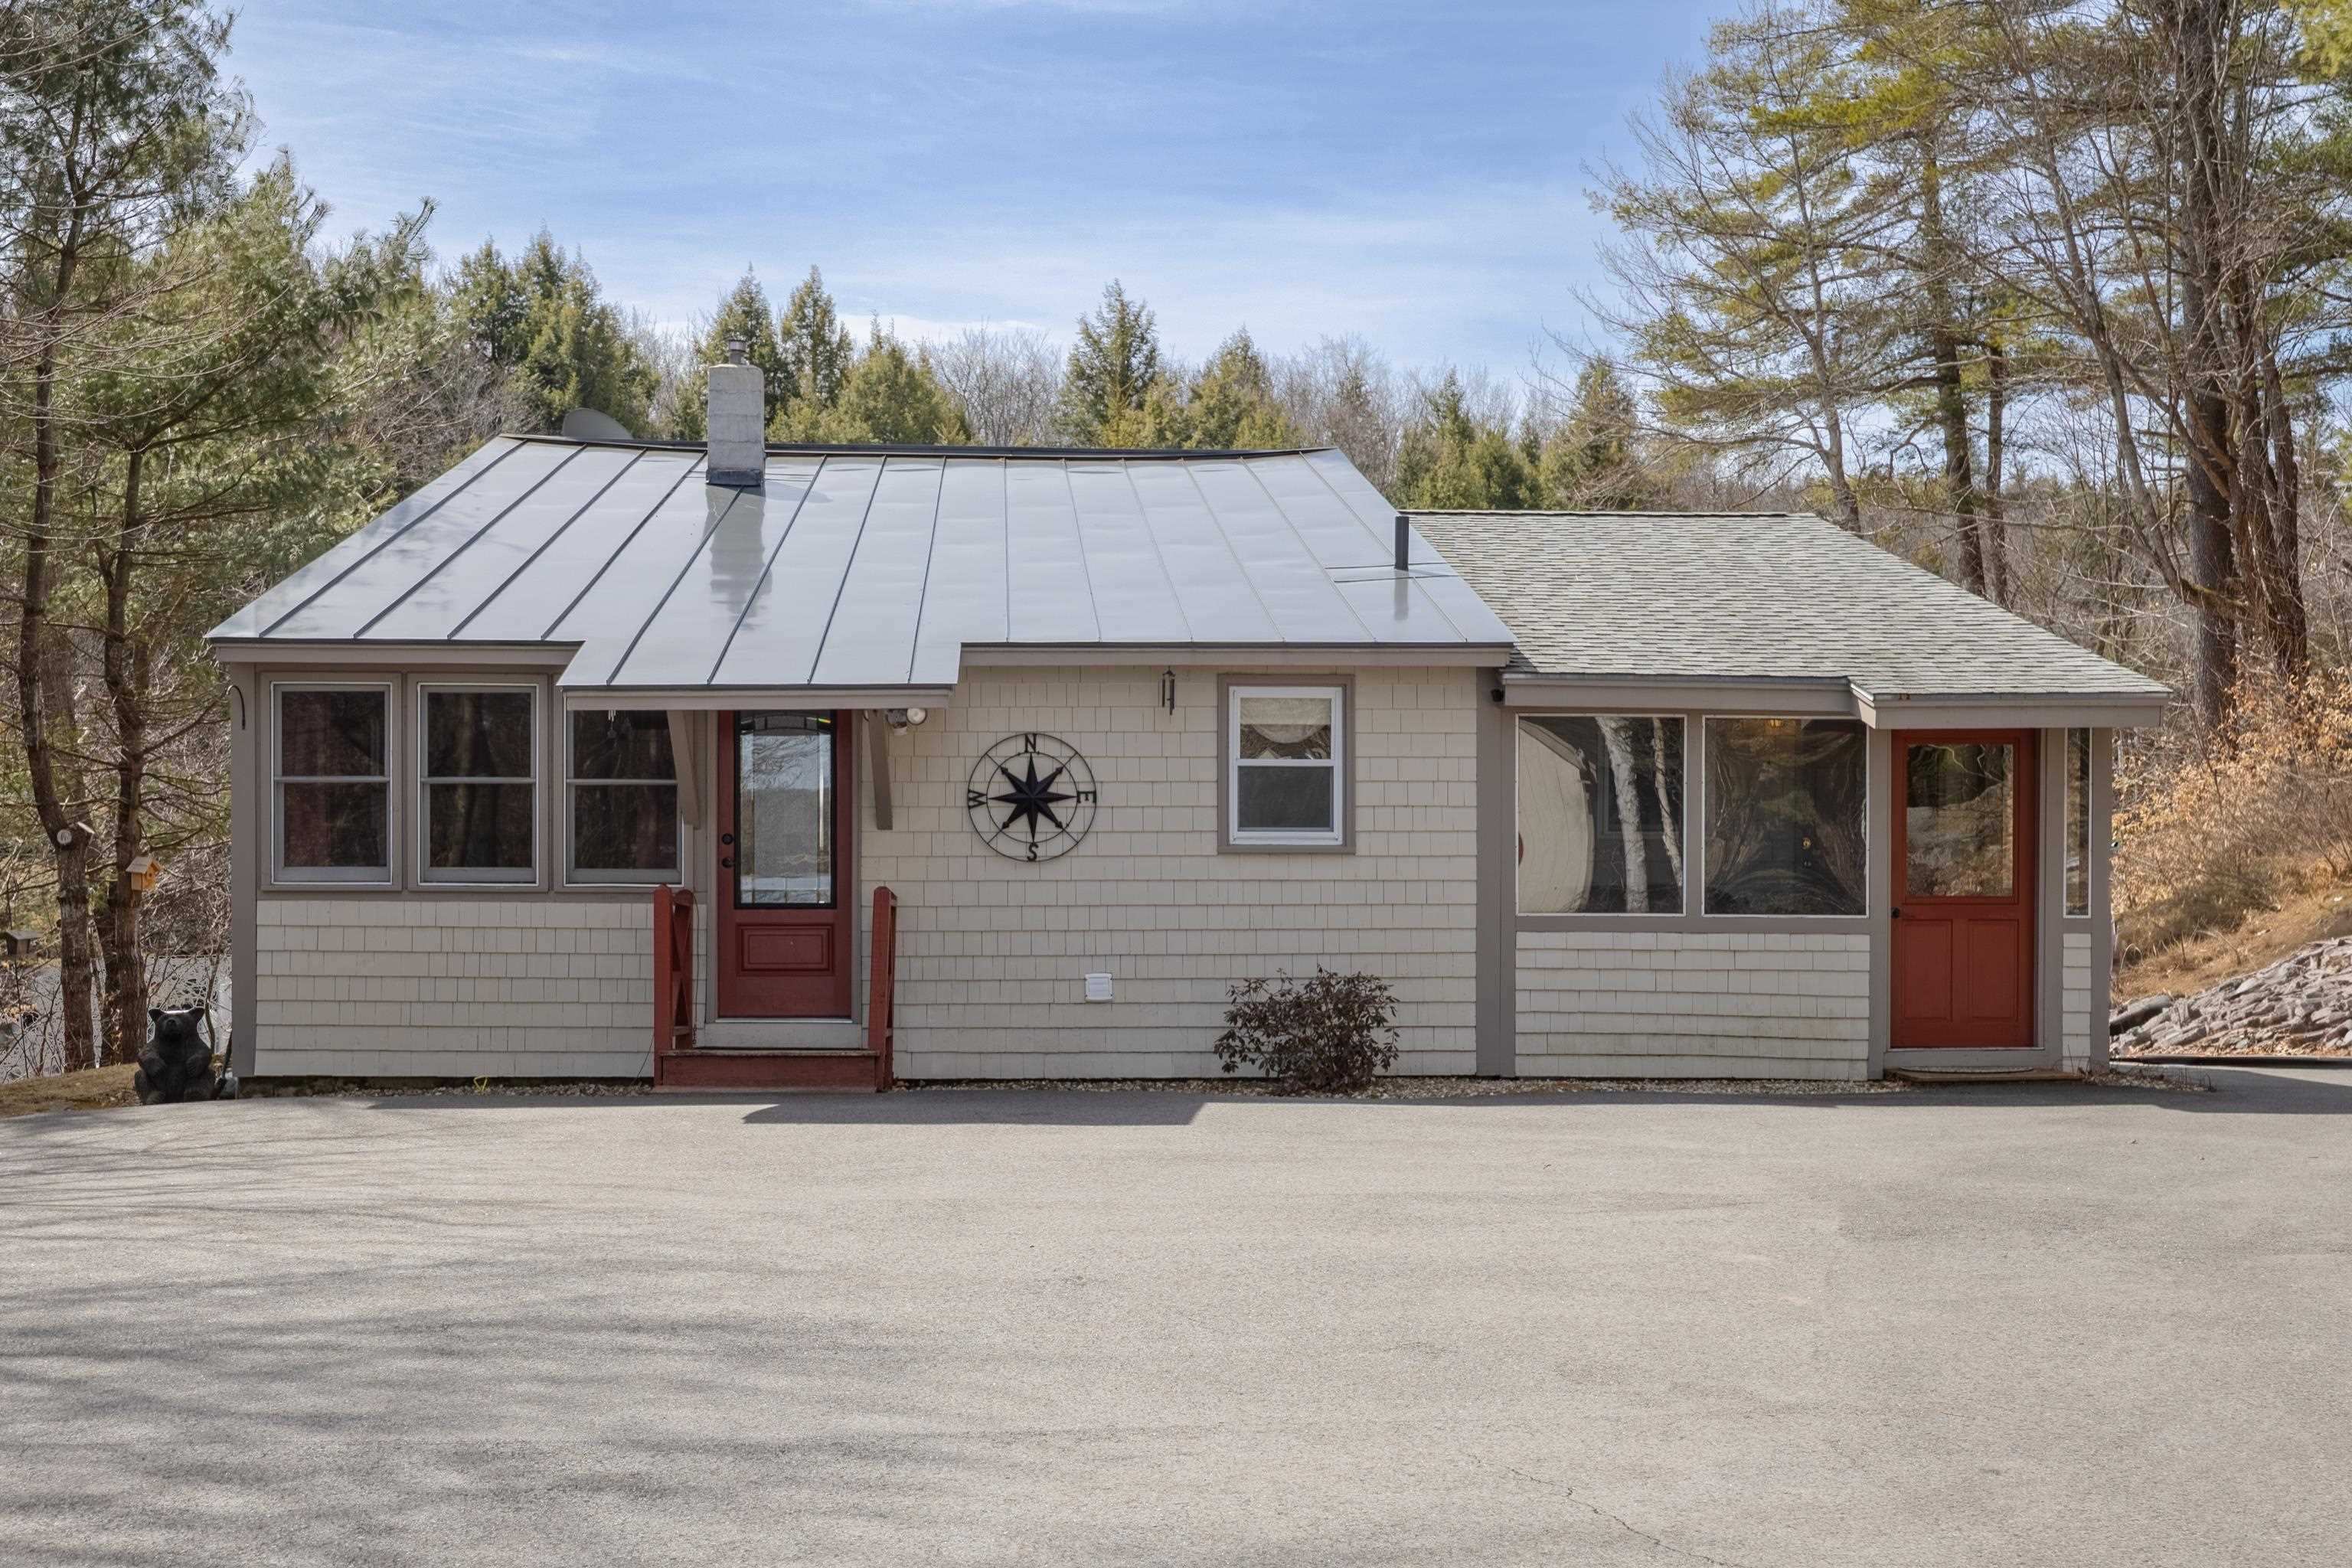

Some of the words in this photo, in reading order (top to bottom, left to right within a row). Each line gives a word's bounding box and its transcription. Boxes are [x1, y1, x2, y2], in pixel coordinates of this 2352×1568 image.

[1024, 733, 1037, 753] N
[968, 789, 988, 810] W
[1076, 790, 1096, 803] E
[1027, 842, 1039, 861] S
